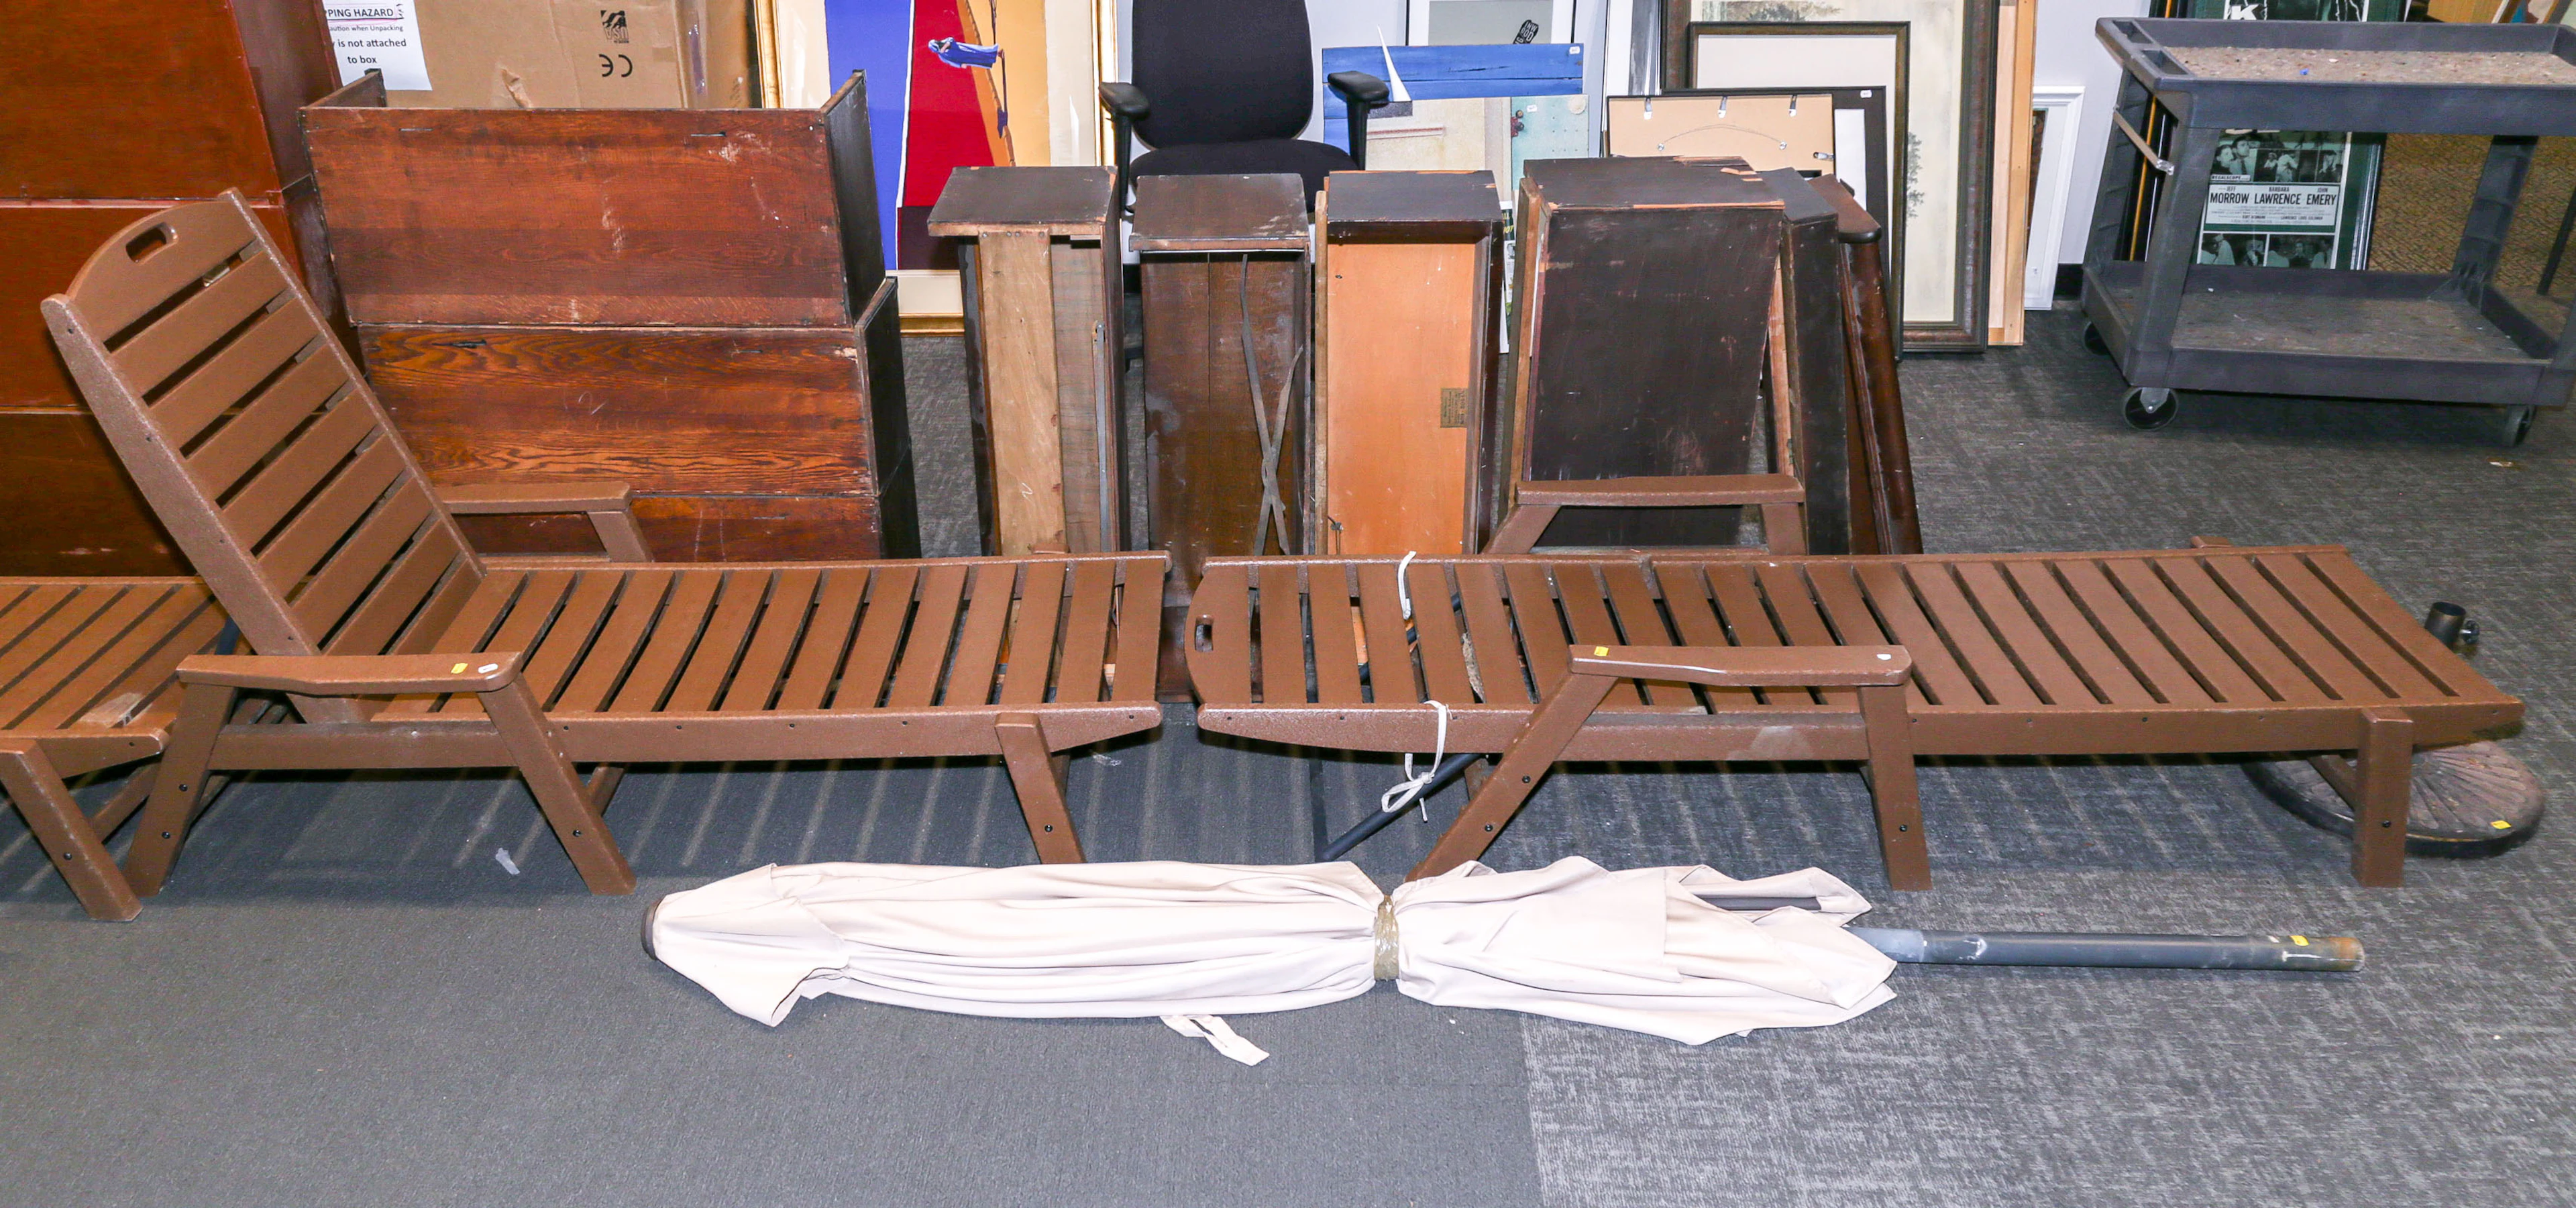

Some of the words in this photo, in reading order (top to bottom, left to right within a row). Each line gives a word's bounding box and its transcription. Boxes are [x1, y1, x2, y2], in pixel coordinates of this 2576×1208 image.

[325, 9, 352, 17] PING
[354, 8, 394, 17] HAZARD
[338, 39, 345, 48] is
[366, 38, 407, 47] attached
[347, 56, 358, 64] to
[360, 55, 377, 64] box
[2210, 192, 2249, 204] MORROW
[2254, 193, 2302, 205] LAWRENCE
[2306, 194, 2337, 205] EMERY
